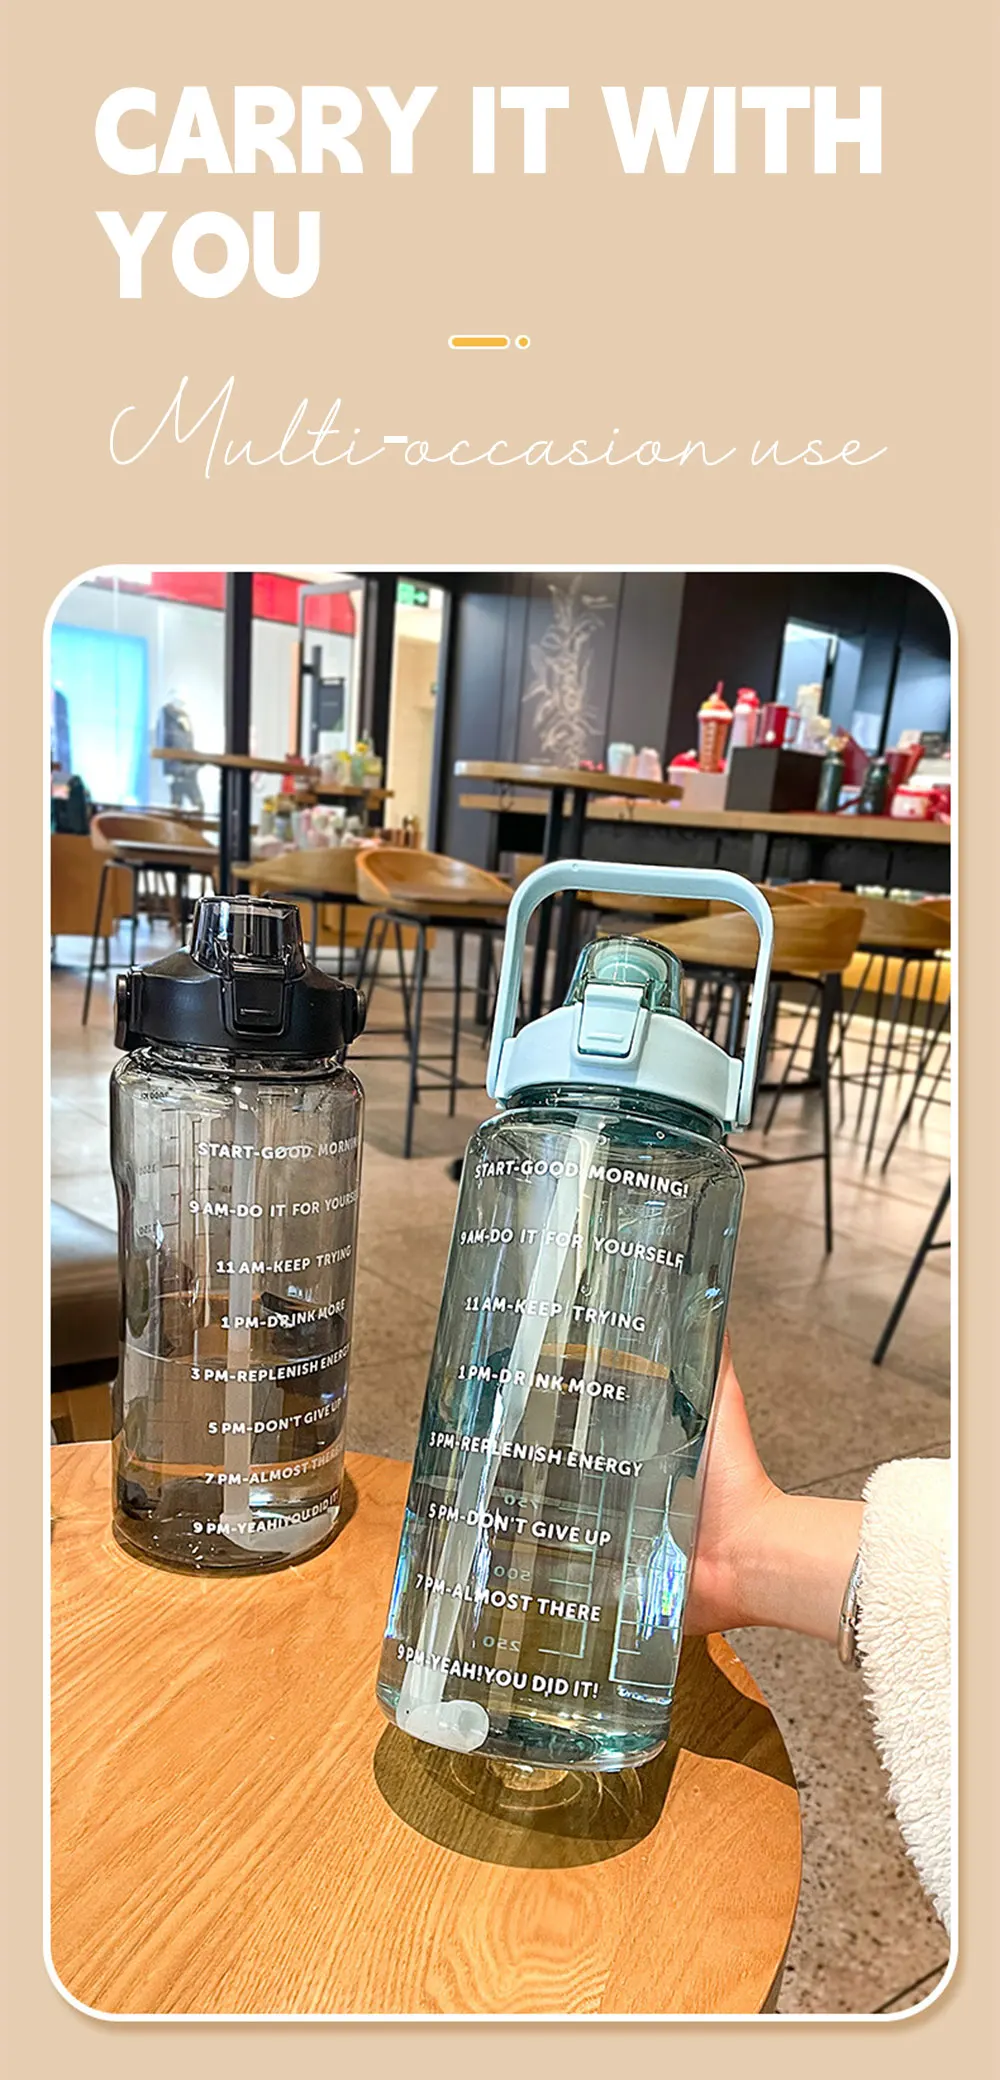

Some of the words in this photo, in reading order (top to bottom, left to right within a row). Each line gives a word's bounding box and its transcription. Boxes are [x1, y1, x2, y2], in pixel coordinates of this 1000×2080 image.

[198, 1143, 313, 1160] START-GOOD
[474, 1160, 578, 1181] START-GOOD
[588, 1166, 690, 1199] MORNING!
[203, 1203, 263, 1218] AM-DO
[270, 1204, 286, 1217] IT
[292, 1202, 320, 1216] FOR
[520, 1228, 538, 1244] IT
[545, 1232, 584, 1249] FOR
[593, 1236, 685, 1268] YOURSELF
[216, 1260, 235, 1274] 11
[239, 1258, 310, 1274] AM-KEEP
[234, 1309, 316, 1329] PM-DRINK
[318, 1298, 346, 1317] MORE
[573, 1305, 647, 1332] TRYING
[204, 1360, 319, 1382] PM-REPLENISH
[222, 1415, 302, 1434] PM-DON'T
[304, 1404, 331, 1424] GIVE
[217, 1462, 309, 1485] PM-ALMOST
[566, 1451, 644, 1478] ENERGY
[531, 1520, 587, 1544] GIVE
[585, 1525, 613, 1547] UP
[537, 1598, 602, 1622] THERE
[531, 1674, 570, 1698] DID
[573, 1681, 600, 1700] IT!
